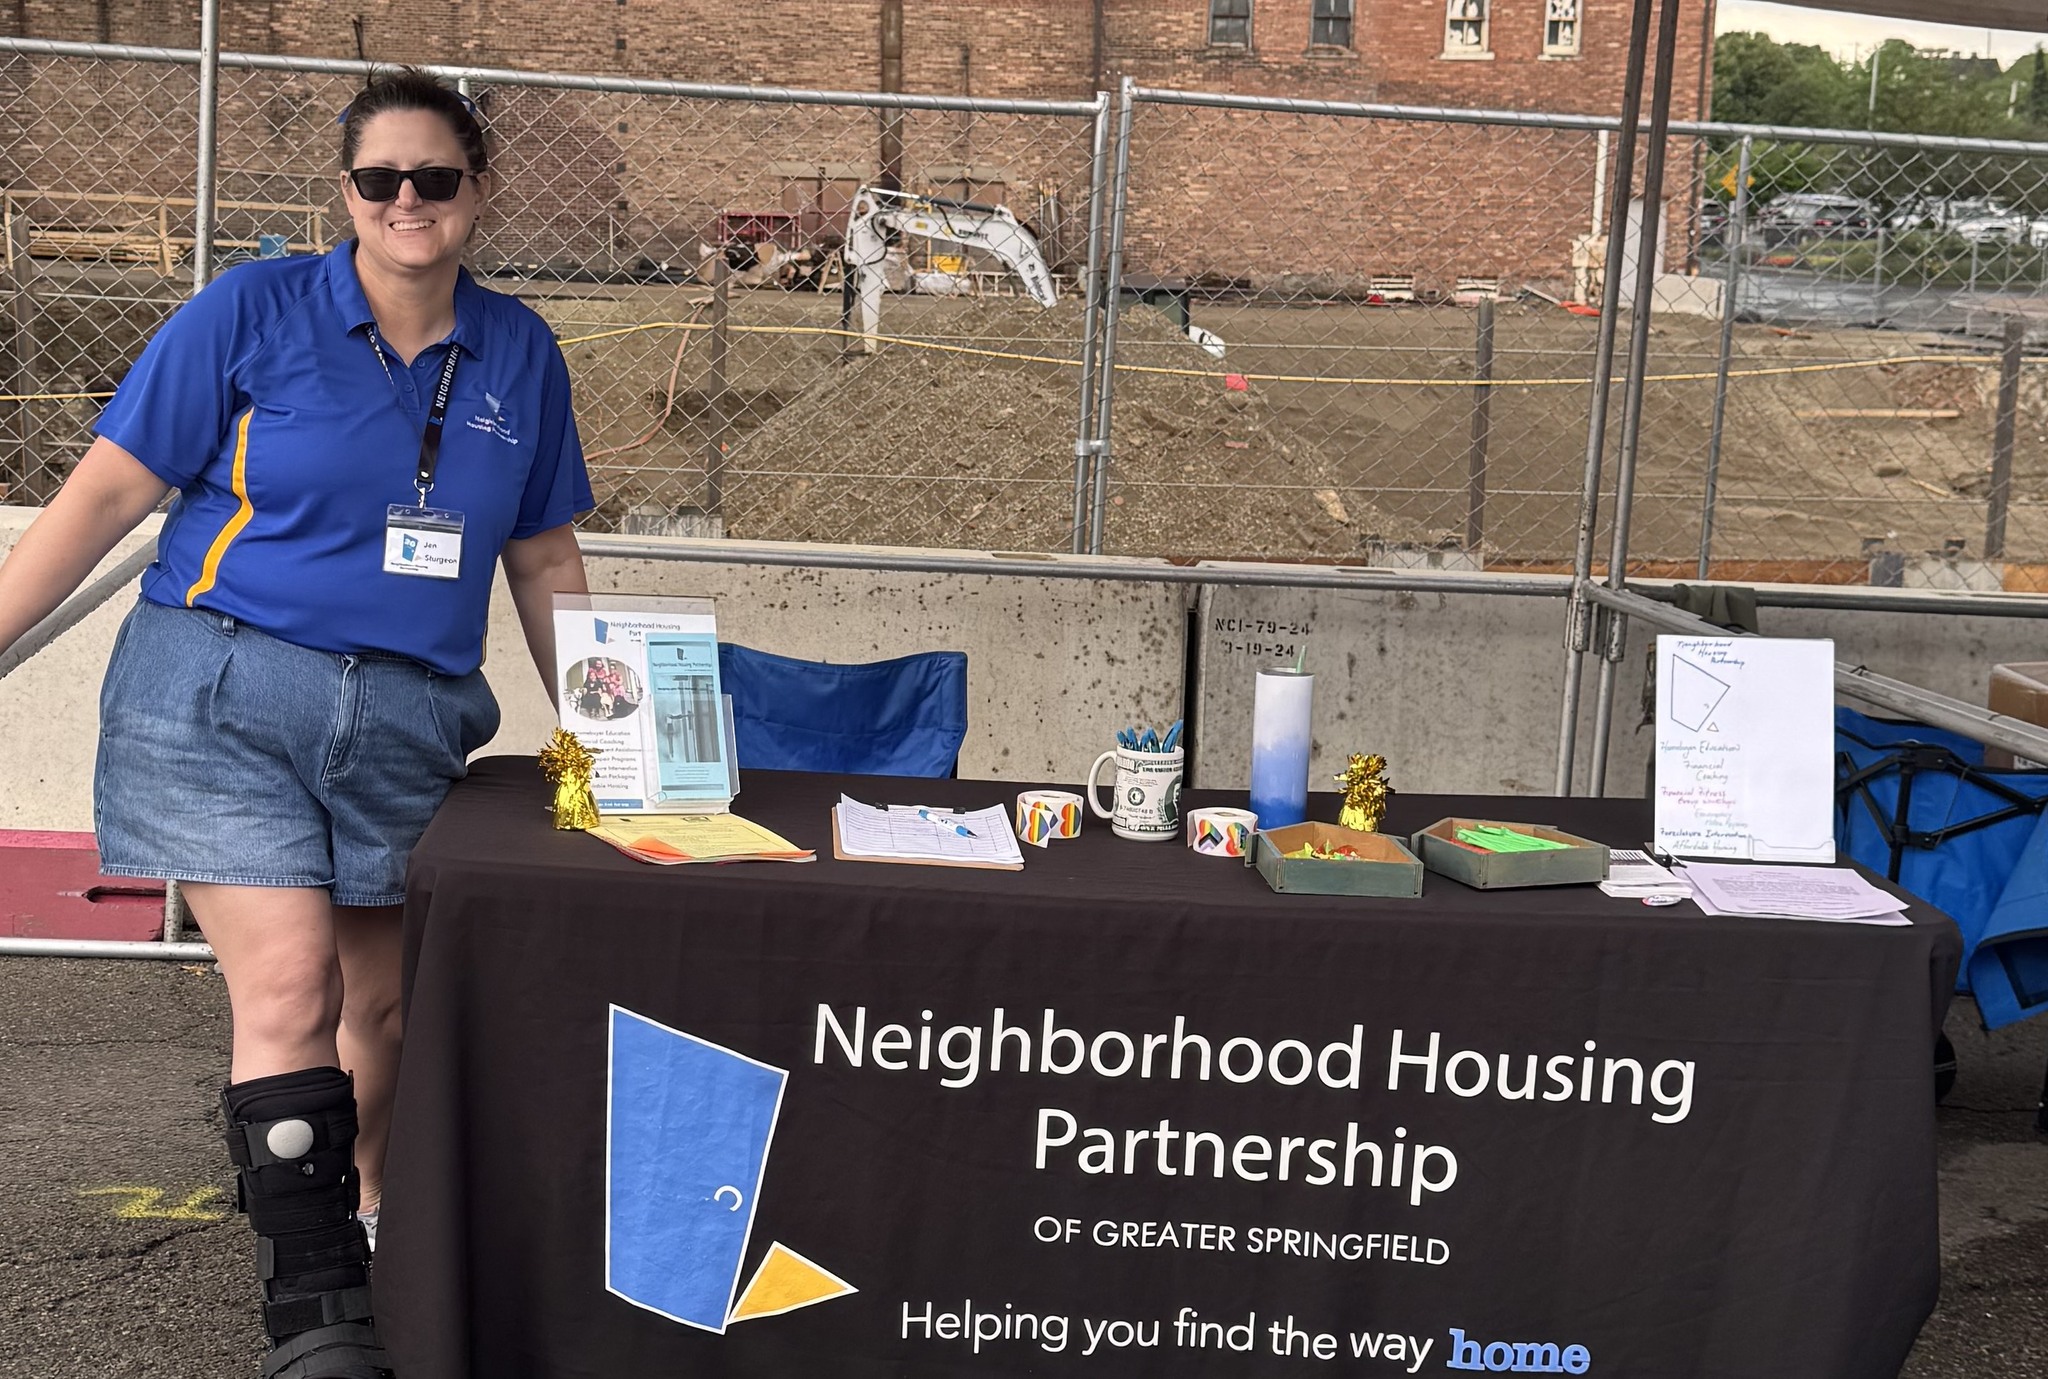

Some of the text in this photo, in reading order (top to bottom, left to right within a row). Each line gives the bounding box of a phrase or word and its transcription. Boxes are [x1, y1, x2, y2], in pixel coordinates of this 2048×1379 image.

[435, 344, 460, 409] NEIGHBORHO
[425, 554, 458, 565] Sturgeon
[610, 621, 655, 630] Neighborhood
[814, 1004, 1696, 1124] Neighborhood Housing
[1035, 1109, 1458, 1207] Partnership
[1033, 1216, 1450, 1265] OF GREATER SPRINGFIELD
[901, 1299, 1592, 1375] Helping you find the way home
